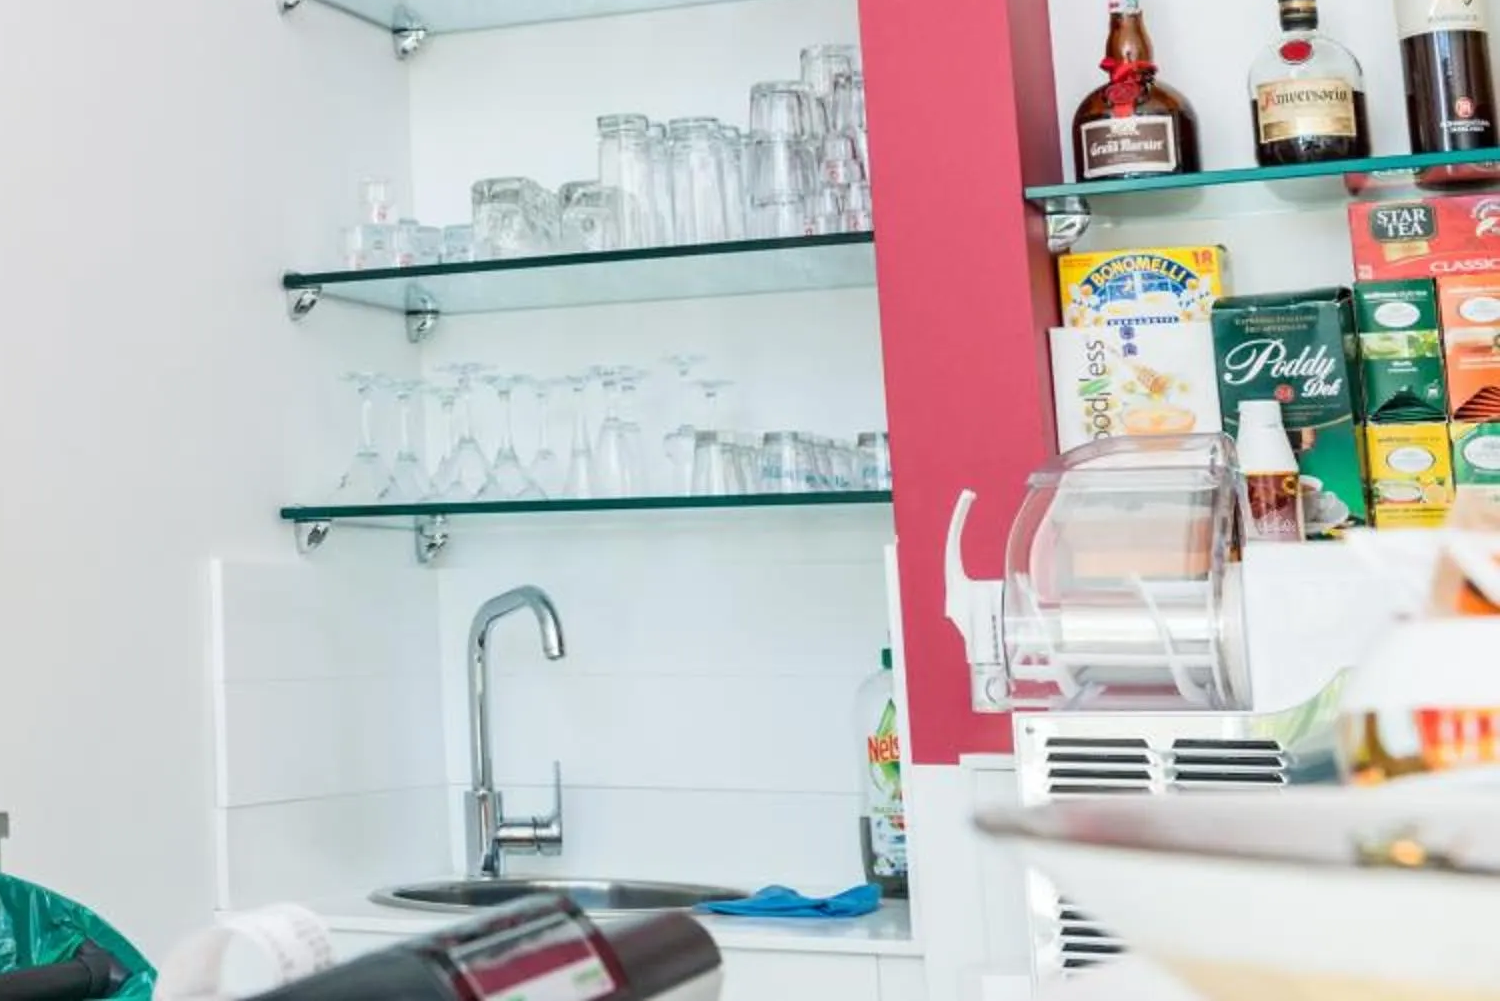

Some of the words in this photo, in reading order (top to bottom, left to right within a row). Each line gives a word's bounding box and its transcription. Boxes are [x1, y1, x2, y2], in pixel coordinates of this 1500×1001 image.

[1376, 207, 1427, 227] STAR
[1384, 221, 1424, 237] TEA
[1091, 256, 1187, 287] BONOMELLI
[1223, 338, 1337, 385] Poddy
